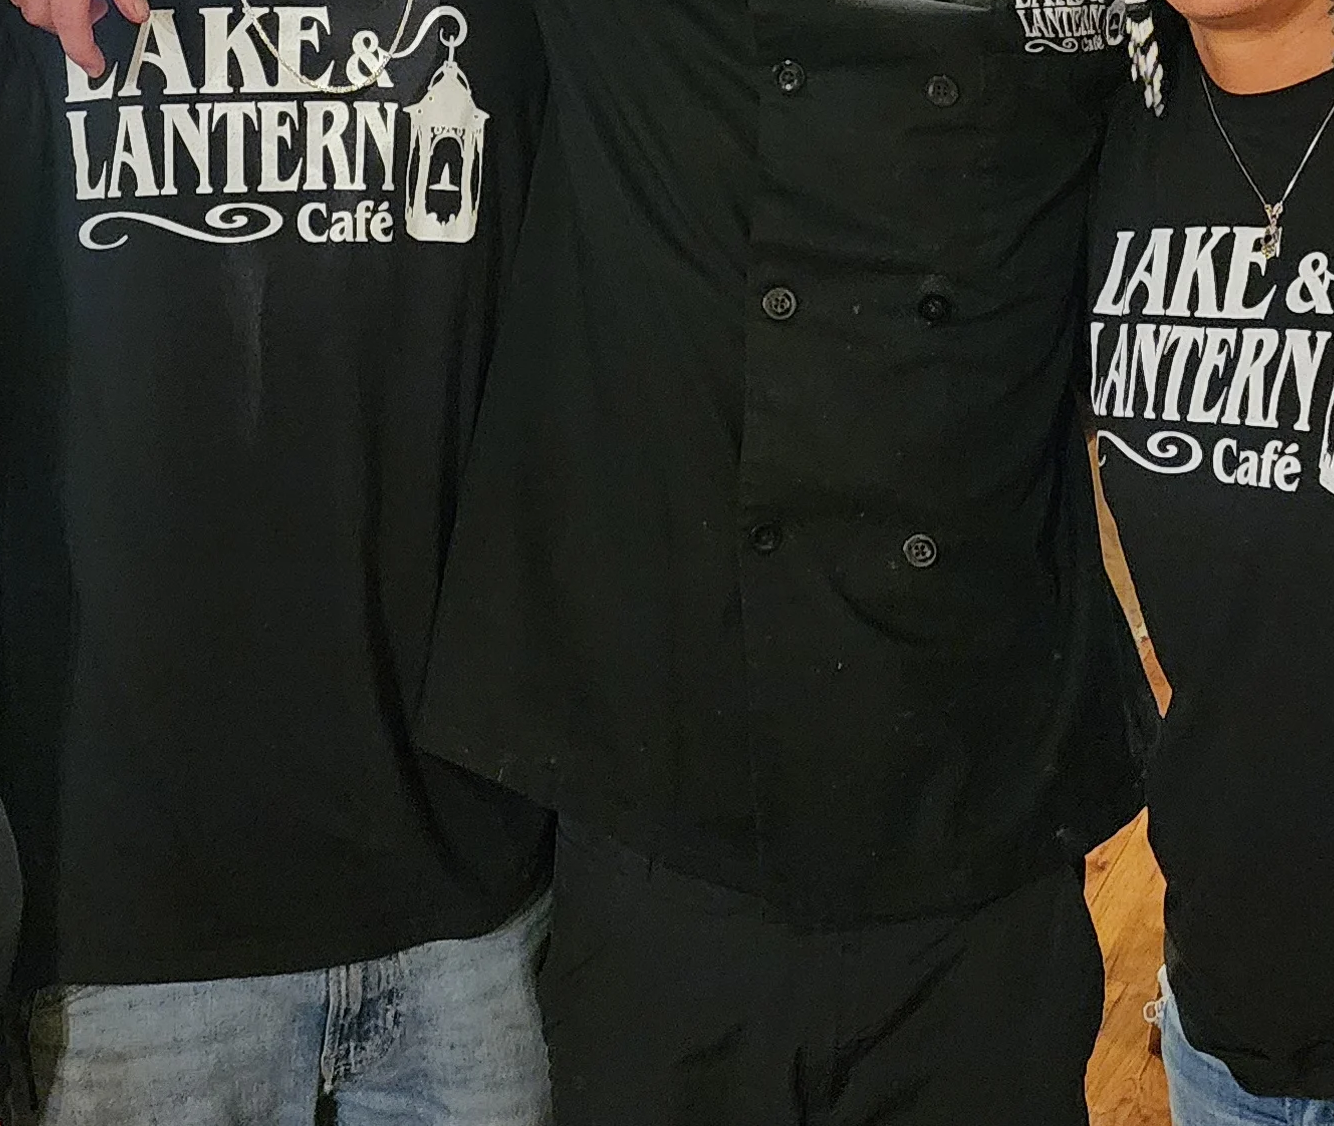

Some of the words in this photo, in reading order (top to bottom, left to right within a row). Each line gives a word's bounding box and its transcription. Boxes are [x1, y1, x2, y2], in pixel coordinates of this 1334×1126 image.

[1016, 4, 1106, 37] LANTERN
[347, 30, 393, 88] &
[66, 101, 399, 201] LANTERN
[297, 199, 394, 243] Café
[1092, 226, 1283, 320] LAKE
[1285, 251, 1334, 315] &
[1089, 321, 1333, 431] LANTERN
[1212, 438, 1302, 492] Café
